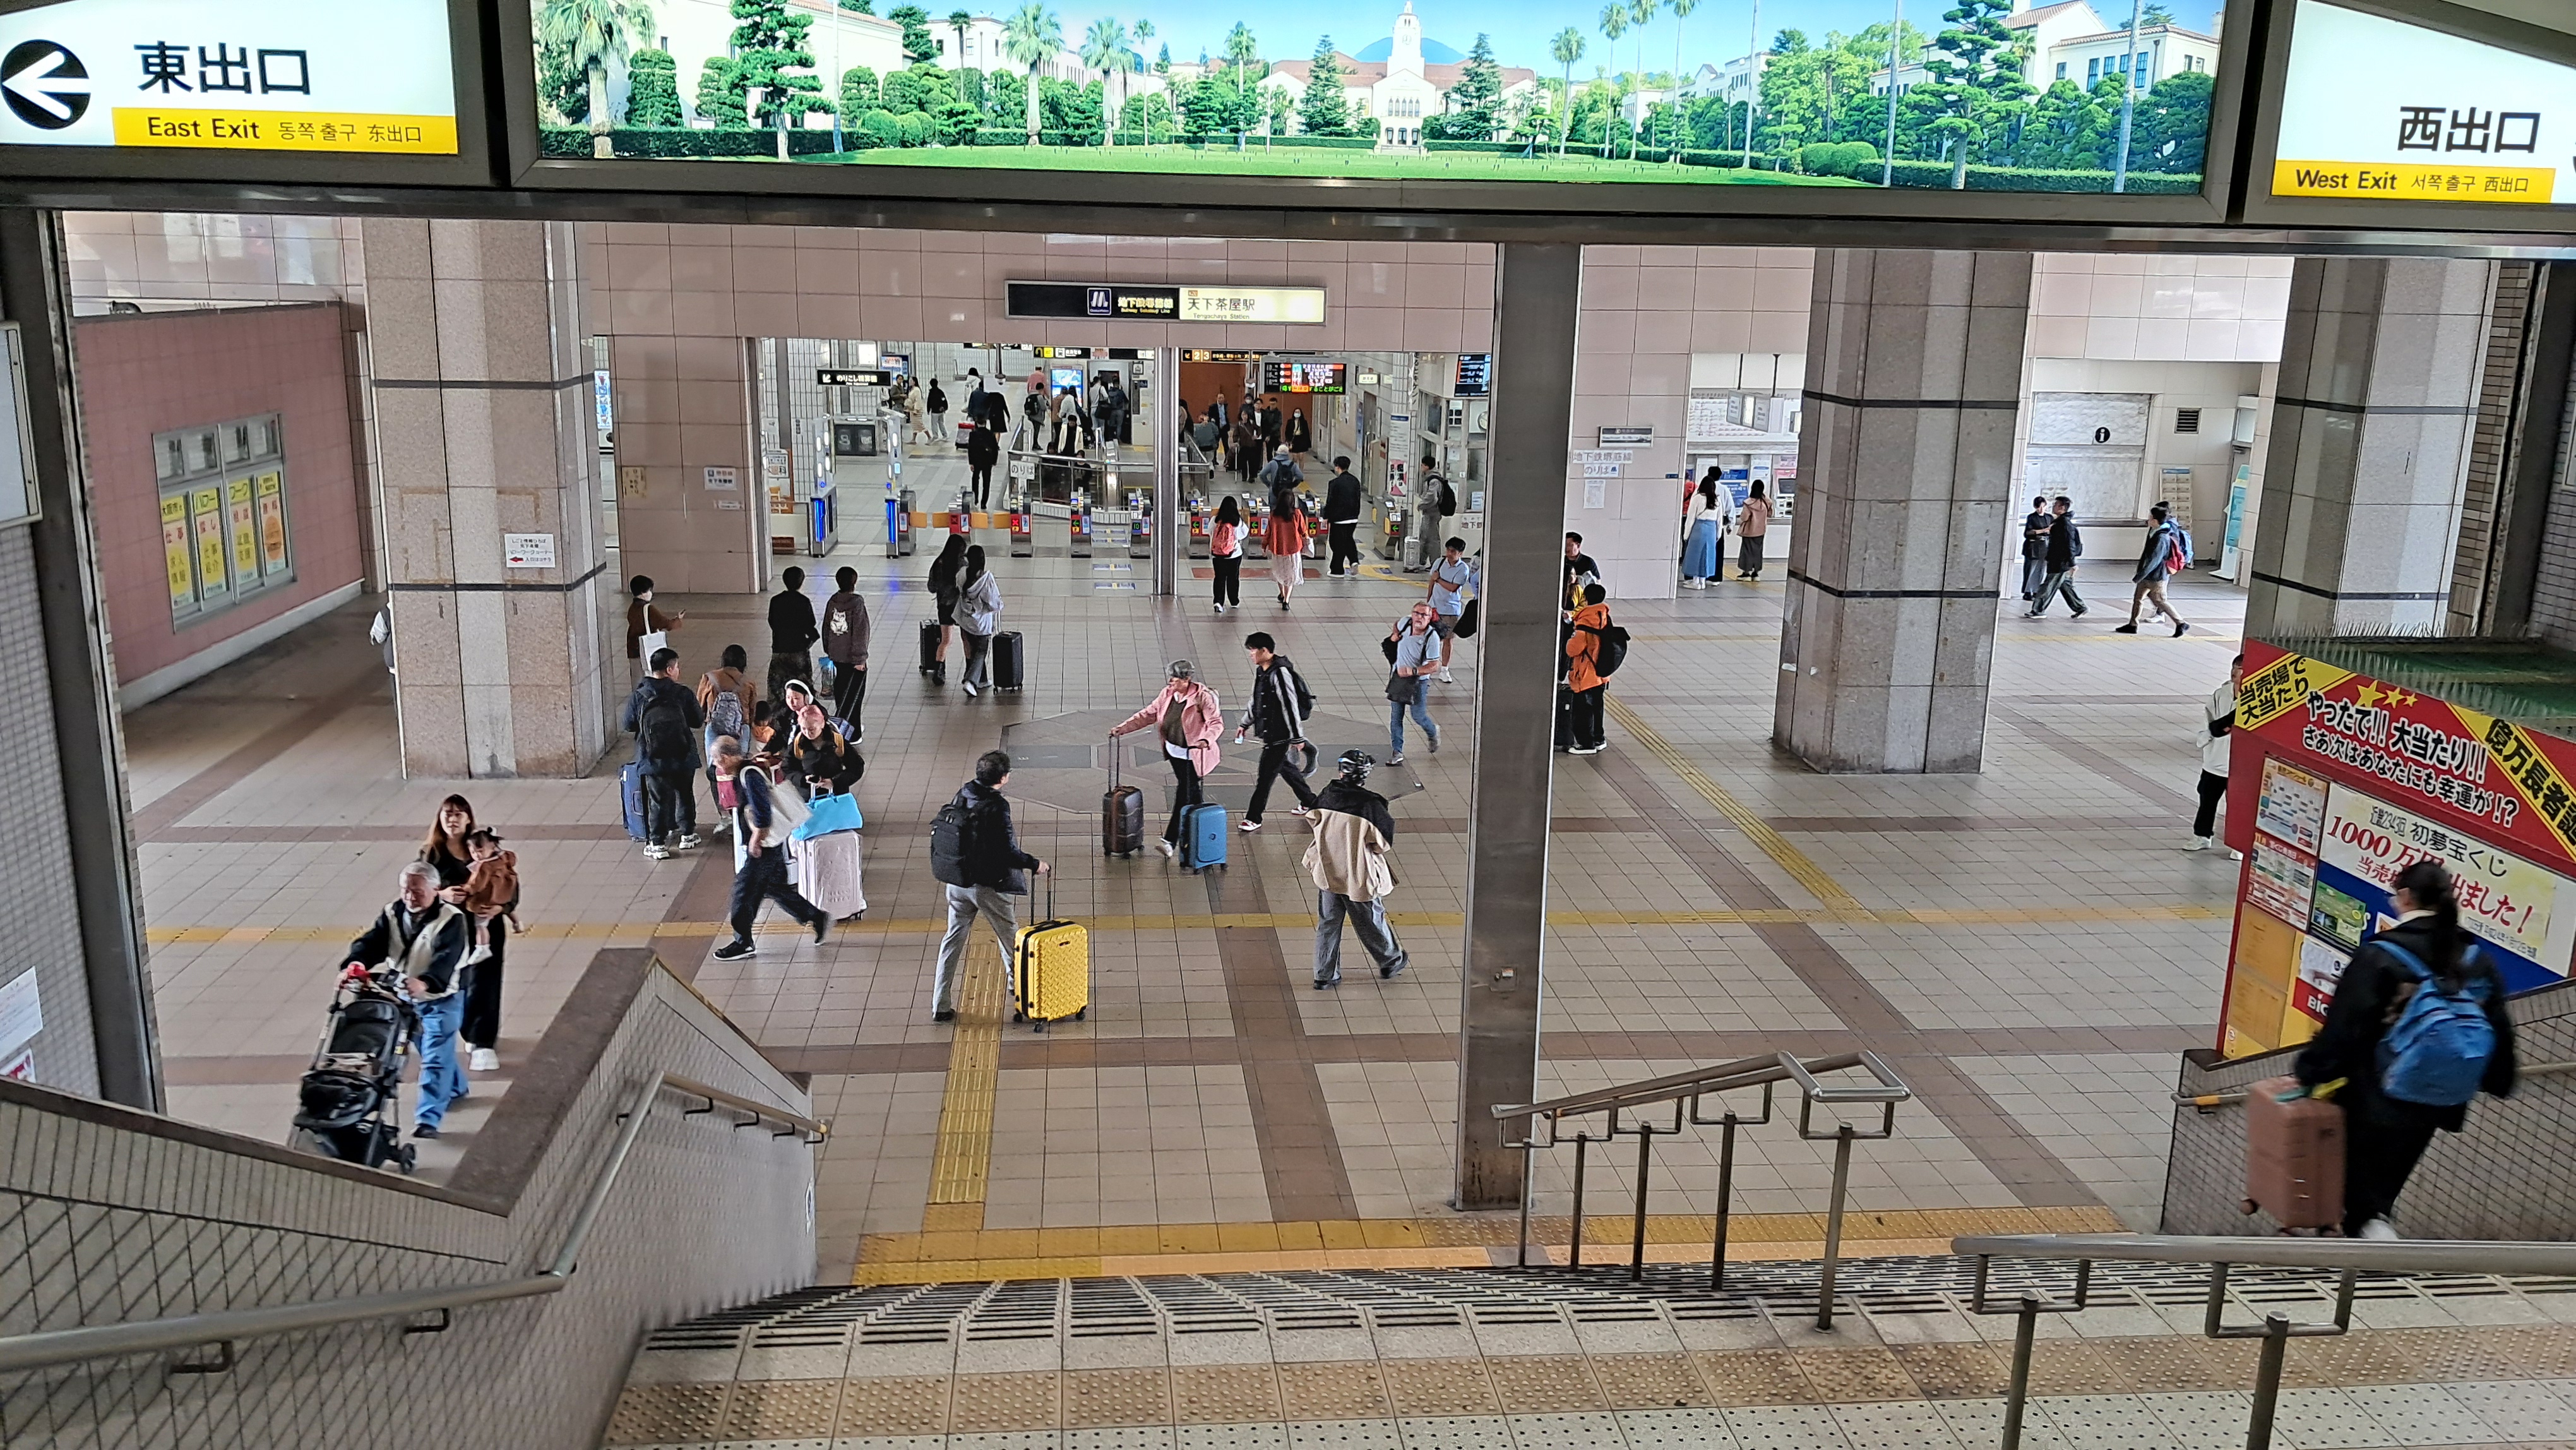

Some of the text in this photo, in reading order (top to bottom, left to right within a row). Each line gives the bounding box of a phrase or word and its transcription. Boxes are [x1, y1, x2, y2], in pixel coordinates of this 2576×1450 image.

[133, 40, 311, 95] 東出口
[148, 117, 260, 140] East Exit
[367, 124, 422, 143] 东出口
[2397, 106, 2541, 153] 西出口
[2296, 169, 2397, 190] West Exit
[2484, 176, 2529, 193] 西出口
[1188, 297, 1255, 311] 天下茶屋駅
[1194, 351, 1200, 360] 2
[1203, 351, 1210, 360] 3
[2239, 655, 2308, 708] 当売場で
[2241, 676, 2309, 726] 大当たり
[2306, 691, 2489, 783] やったで!! 大当たり!!
[2303, 725, 2520, 829] さあ次はあなたにも幸運が!?
[2411, 822, 2507, 878] 初夢宝くじ
